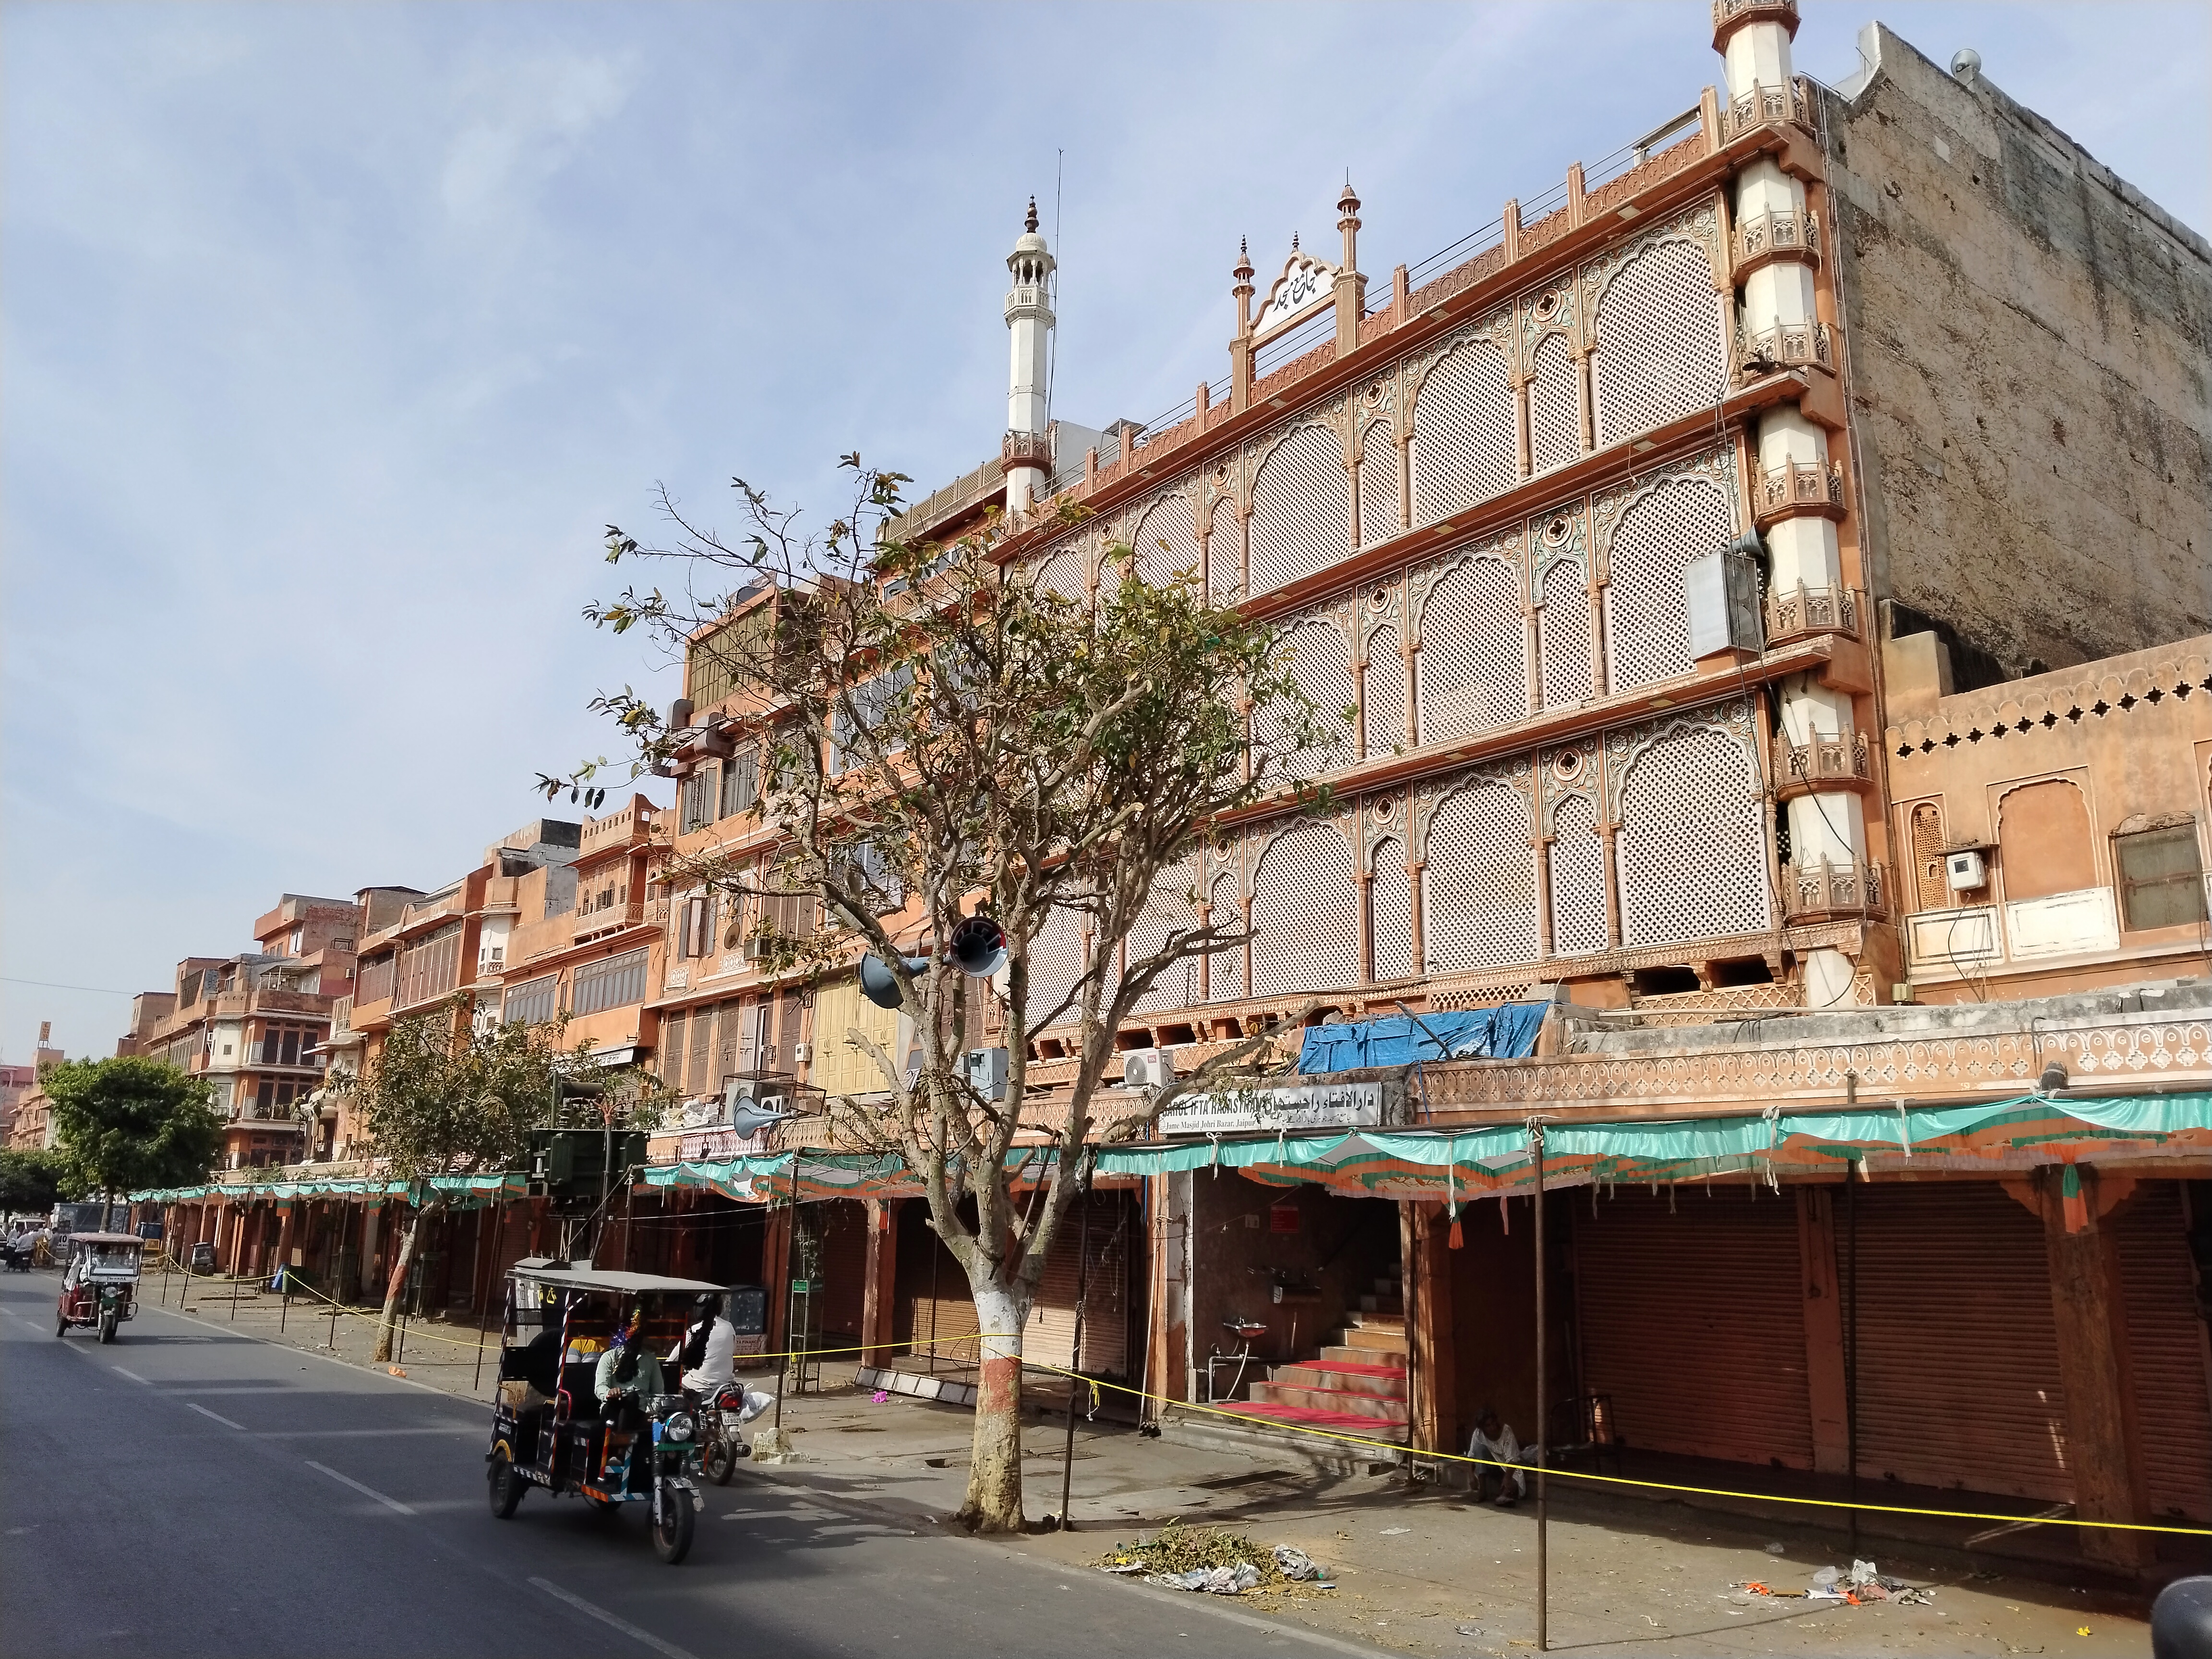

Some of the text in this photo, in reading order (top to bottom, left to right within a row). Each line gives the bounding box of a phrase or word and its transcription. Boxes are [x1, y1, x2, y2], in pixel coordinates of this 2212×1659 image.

[1191, 1100, 1208, 1115] IFTA
[1181, 1121, 1199, 1130] Masjid
[1201, 1120, 1215, 1129] Johri
[1236, 1119, 1255, 1128] Jaipur
